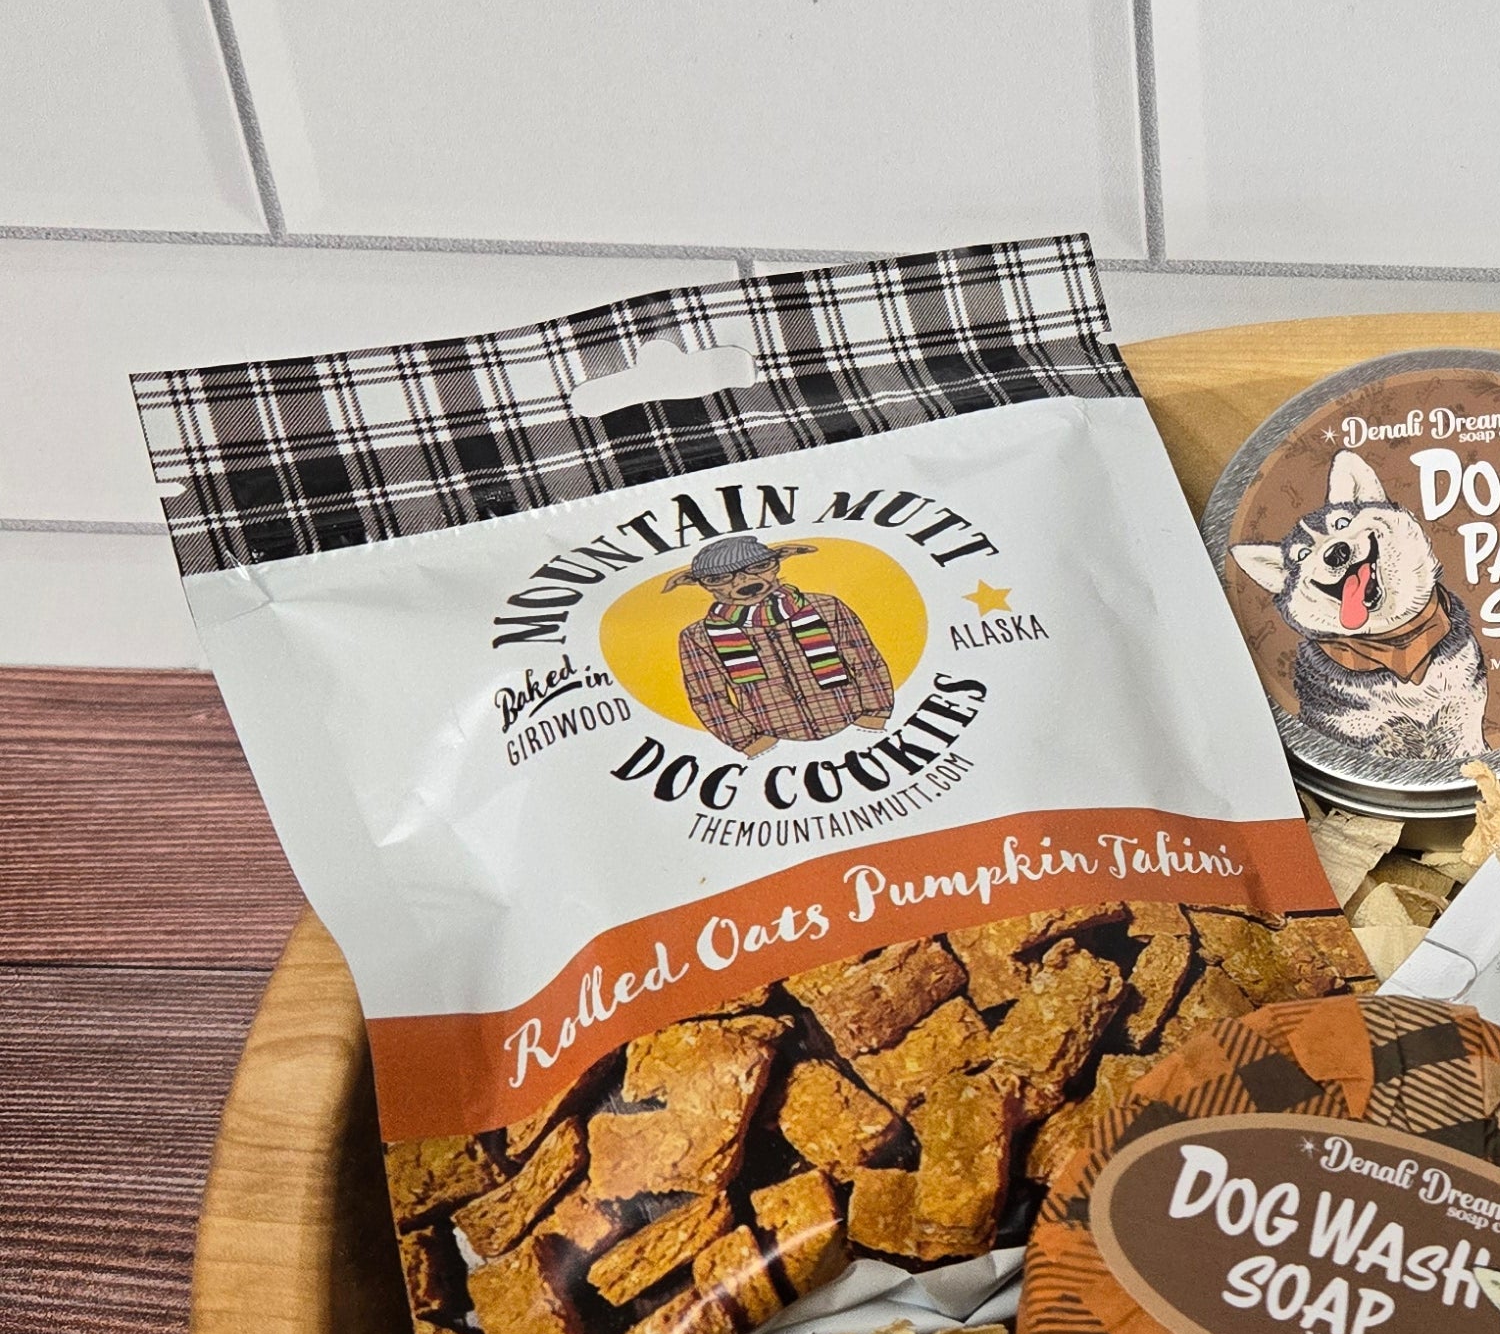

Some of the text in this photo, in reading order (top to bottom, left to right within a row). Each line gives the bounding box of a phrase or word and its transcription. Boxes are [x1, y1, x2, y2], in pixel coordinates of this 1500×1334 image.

[1341, 409, 1424, 448] Denali
[1459, 429, 1495, 444] soap
[492, 484, 999, 649] MOUNTAIN MUTT
[950, 614, 1050, 651] ALASKA
[494, 654, 613, 733] Baked in
[507, 698, 631, 765] GIRDWOOD
[610, 672, 989, 812] DOG COOKIES
[688, 753, 976, 848] THEMOUNTAINMUTT.COM
[503, 830, 1243, 1087] Rolled Oats Pumpkin Tahini
[1321, 1135, 1417, 1190] Denali
[1169, 1145, 1494, 1309] DOG WASH
[1446, 1204, 1490, 1233] soap
